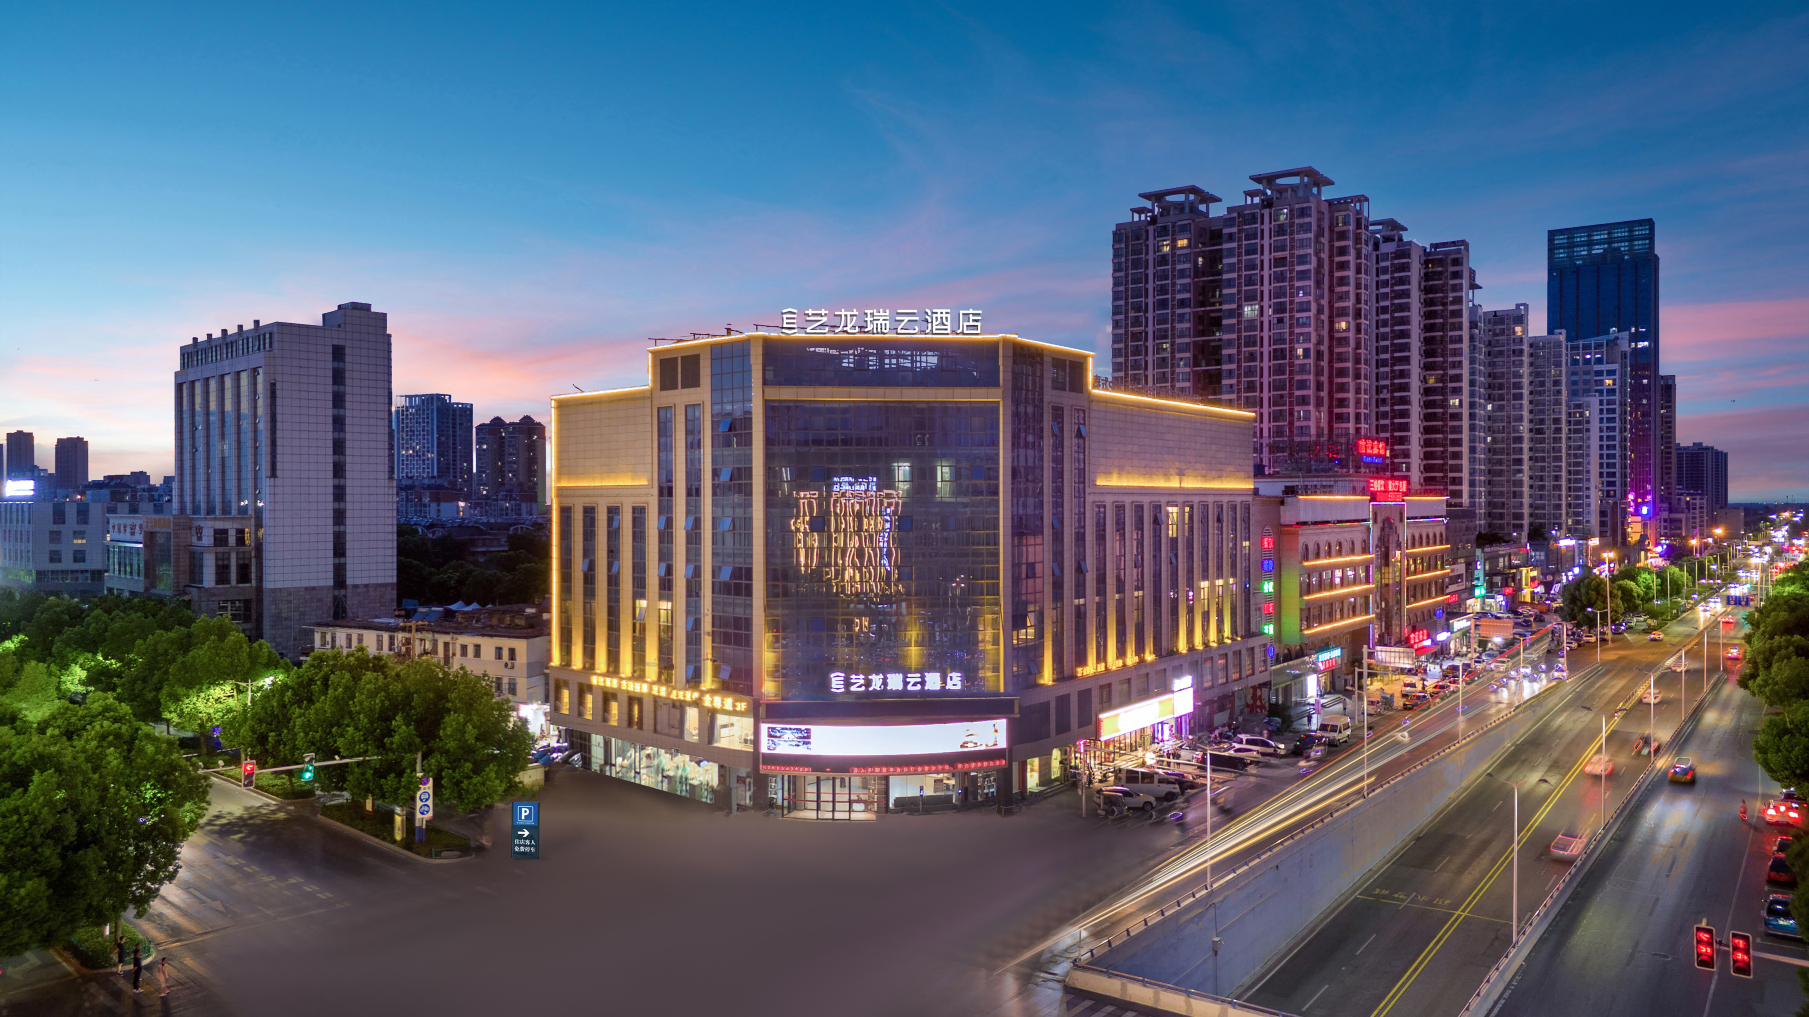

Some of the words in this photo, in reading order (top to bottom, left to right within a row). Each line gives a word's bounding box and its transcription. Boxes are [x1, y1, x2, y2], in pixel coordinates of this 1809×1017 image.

[803, 308, 983, 335] 艺龙瑞云酒店
[849, 672, 963, 692] 艺龙瑞云酒店
[734, 702, 747, 711] 3F
[522, 808, 529, 819] P
